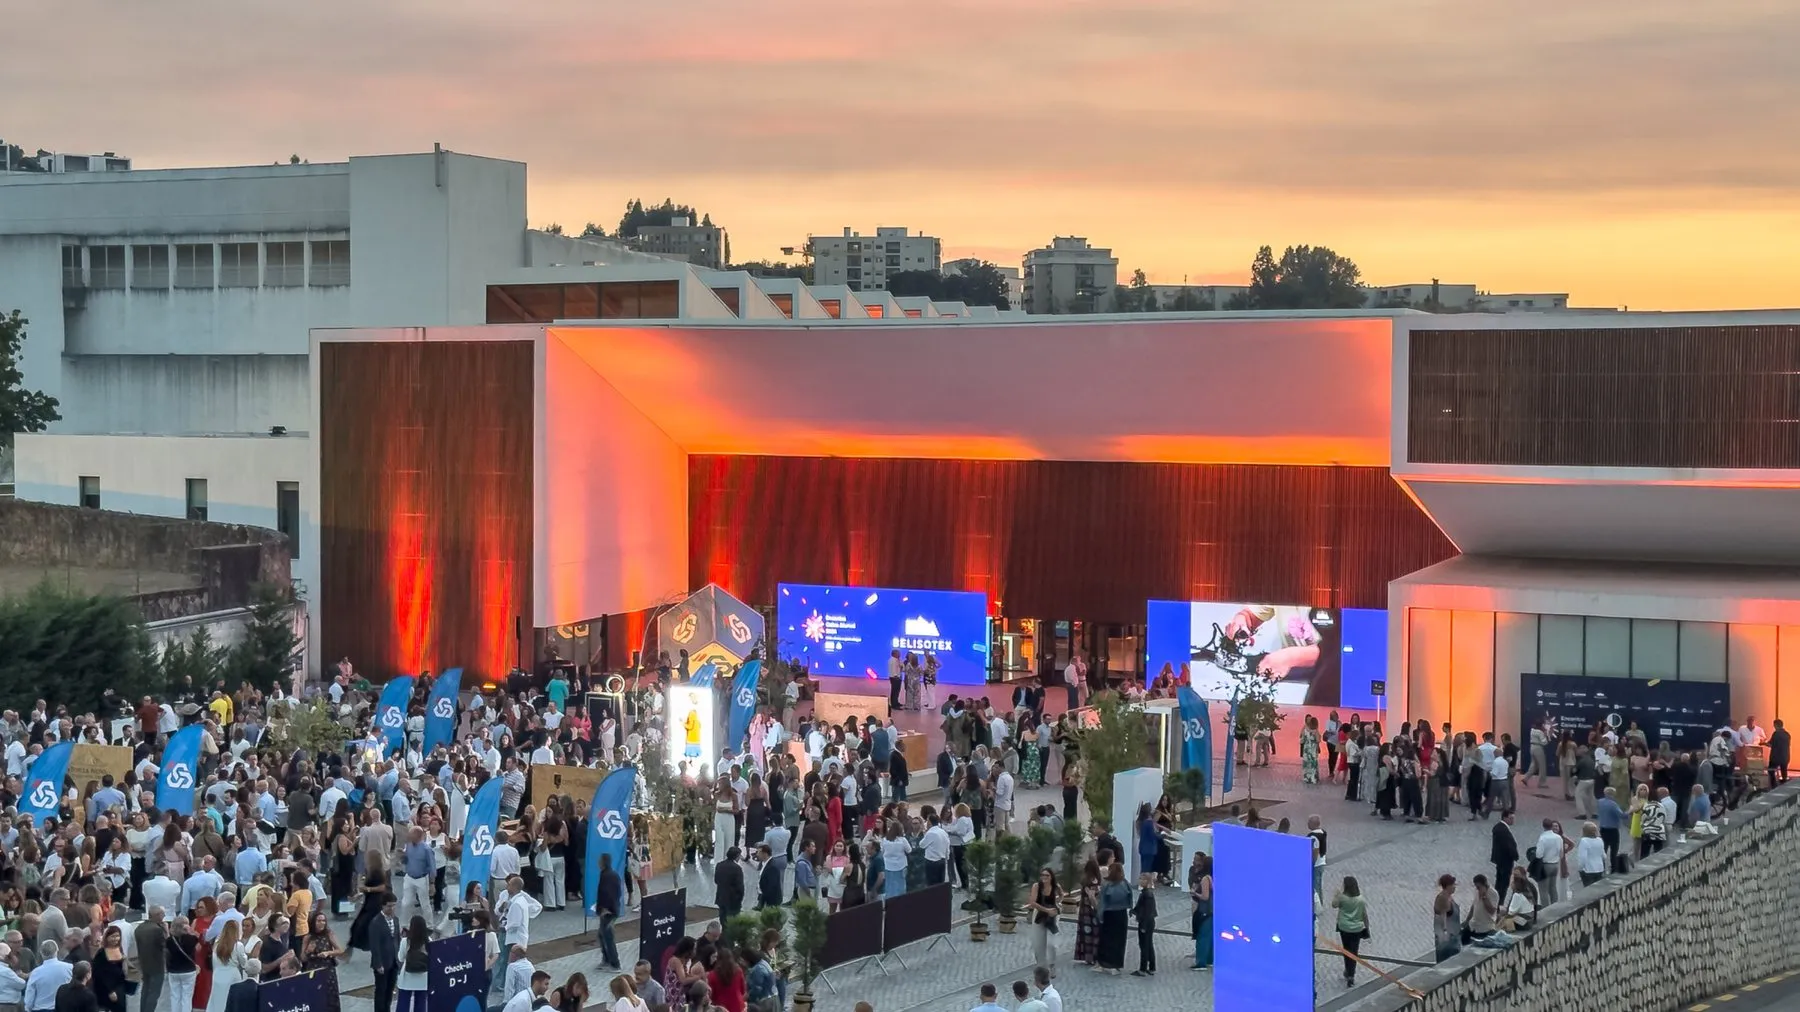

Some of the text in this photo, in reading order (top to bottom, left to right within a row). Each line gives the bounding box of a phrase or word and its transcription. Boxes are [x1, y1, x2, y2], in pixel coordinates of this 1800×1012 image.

[892, 637, 952, 651] BELISOTEX
[653, 915, 675, 926] Check-in
[444, 961, 472, 974] Check-in
